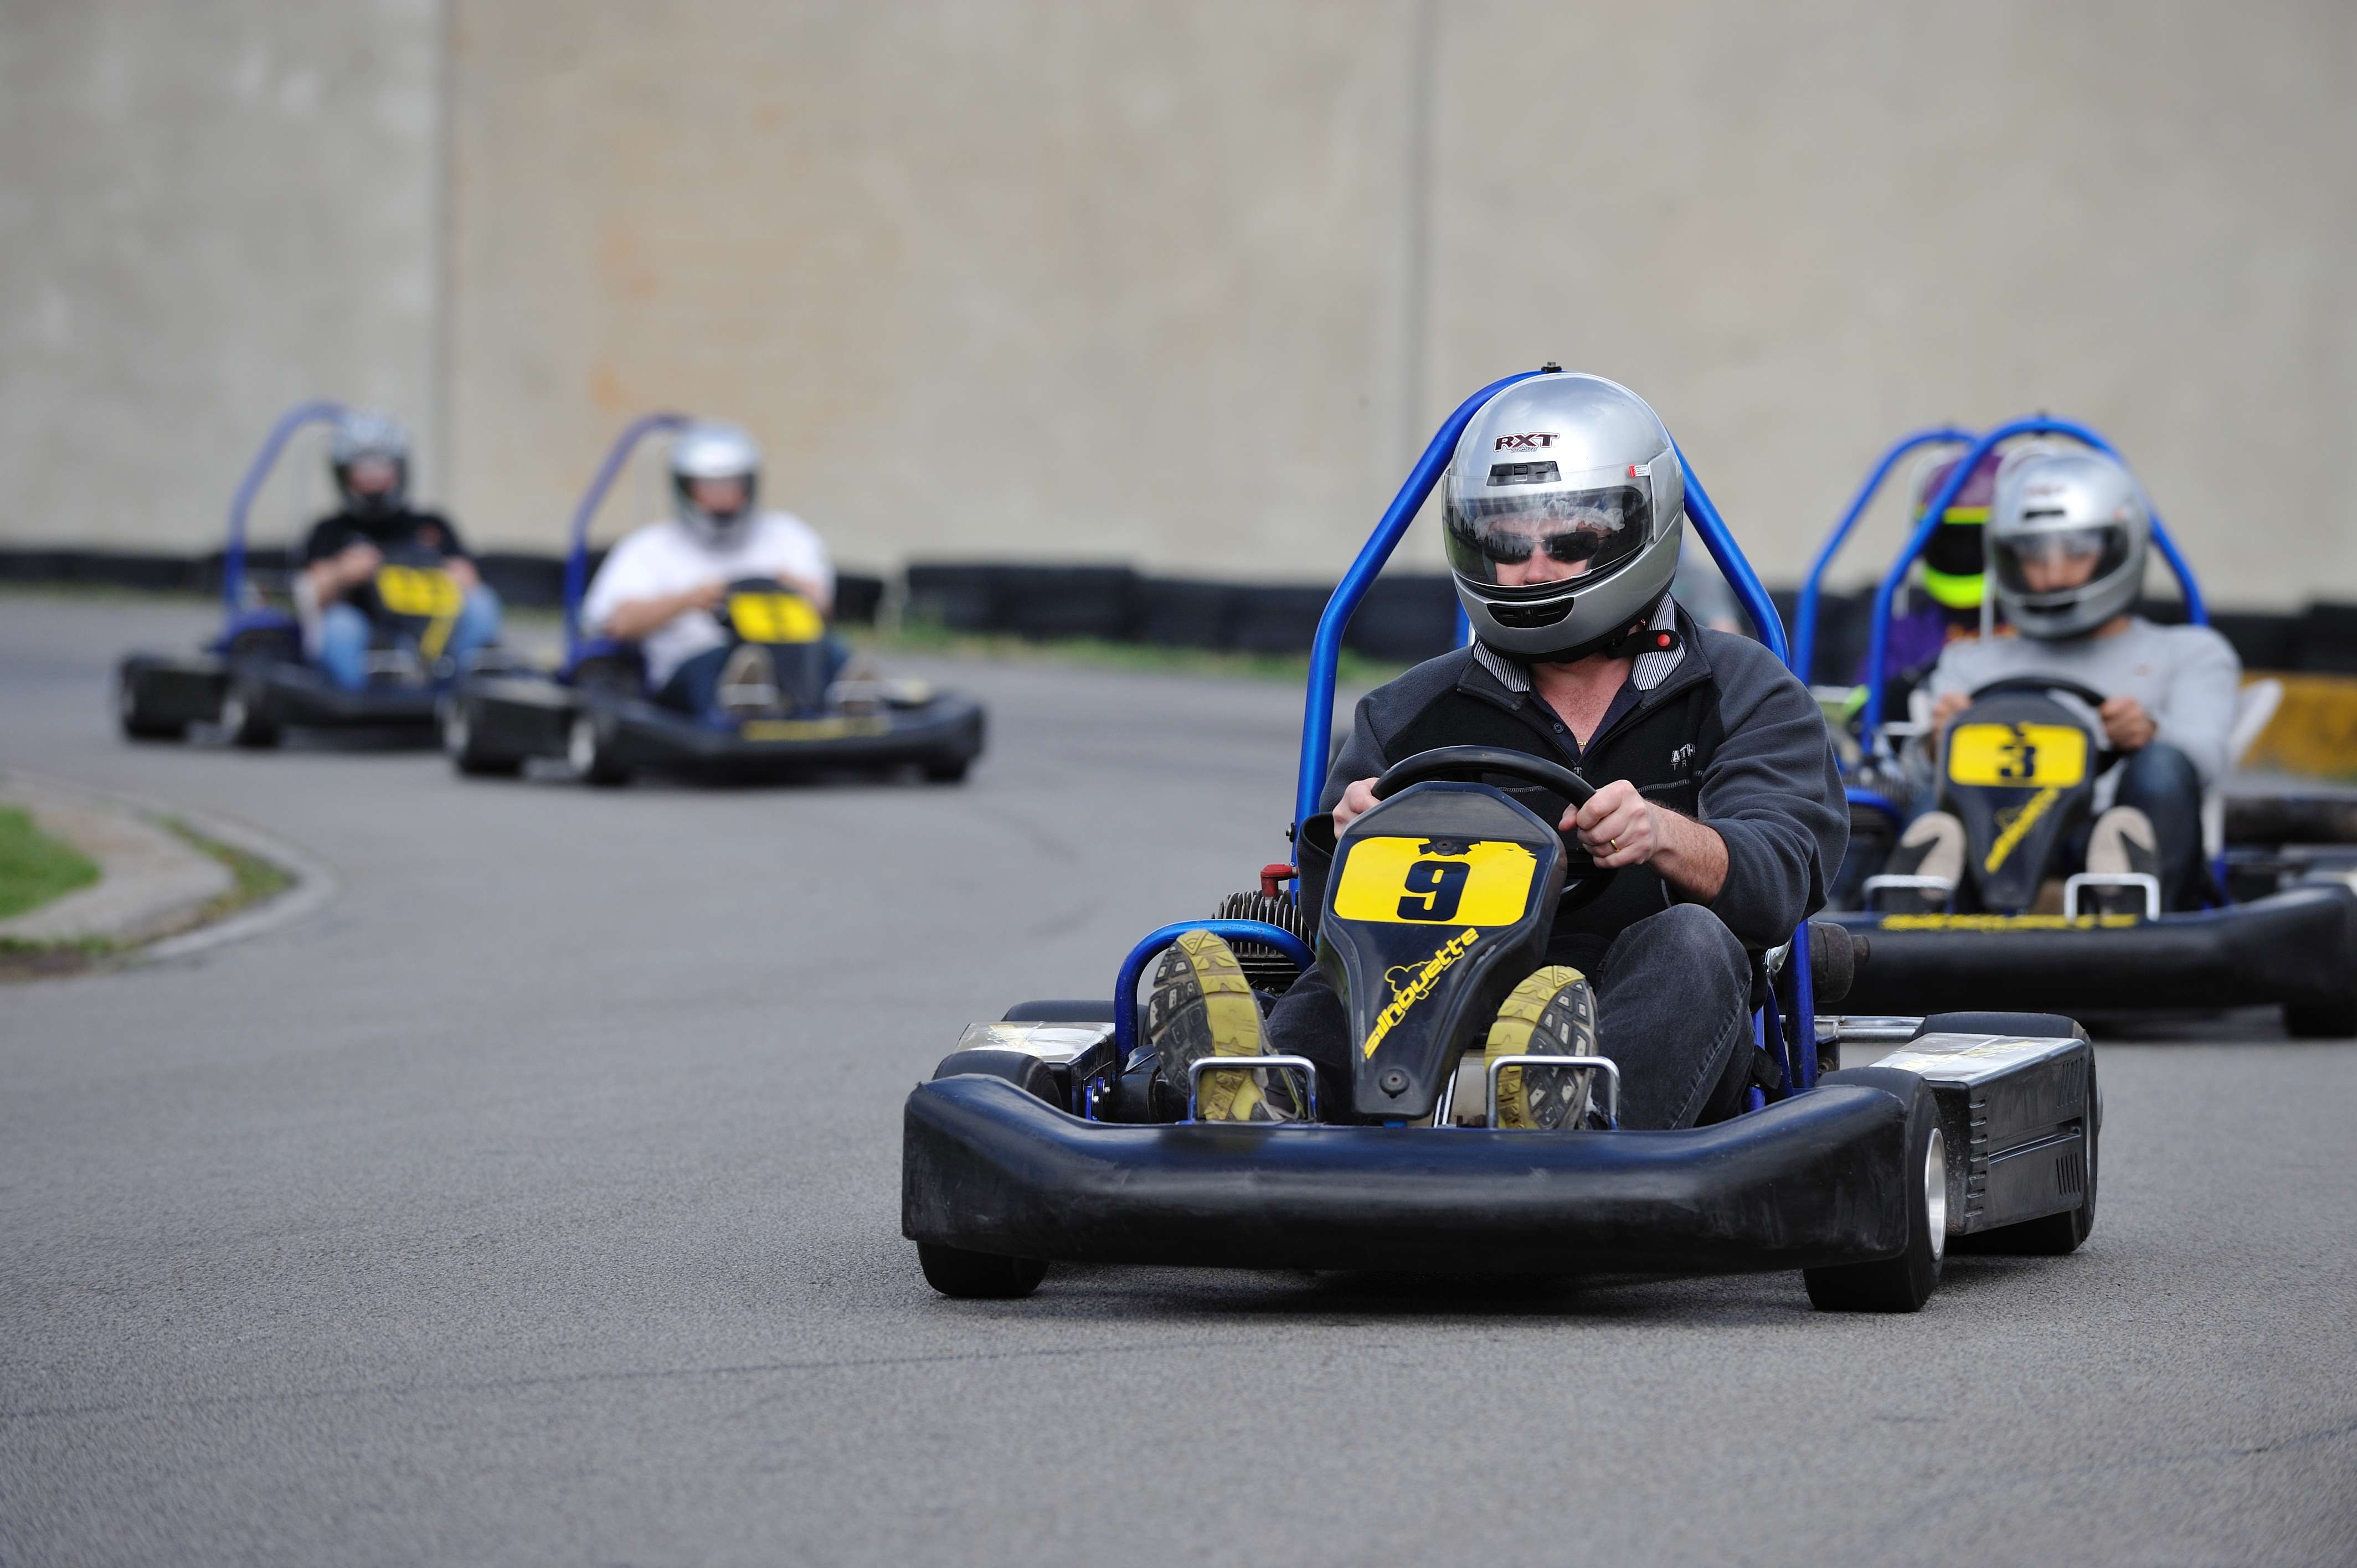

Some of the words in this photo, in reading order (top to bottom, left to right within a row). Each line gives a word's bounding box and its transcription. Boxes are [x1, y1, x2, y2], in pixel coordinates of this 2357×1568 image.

[1494, 433, 1559, 452] RXT
[2001, 745, 2036, 777] 3
[1397, 860, 1471, 921] 9
[1364, 927, 1479, 1059] silhouette
